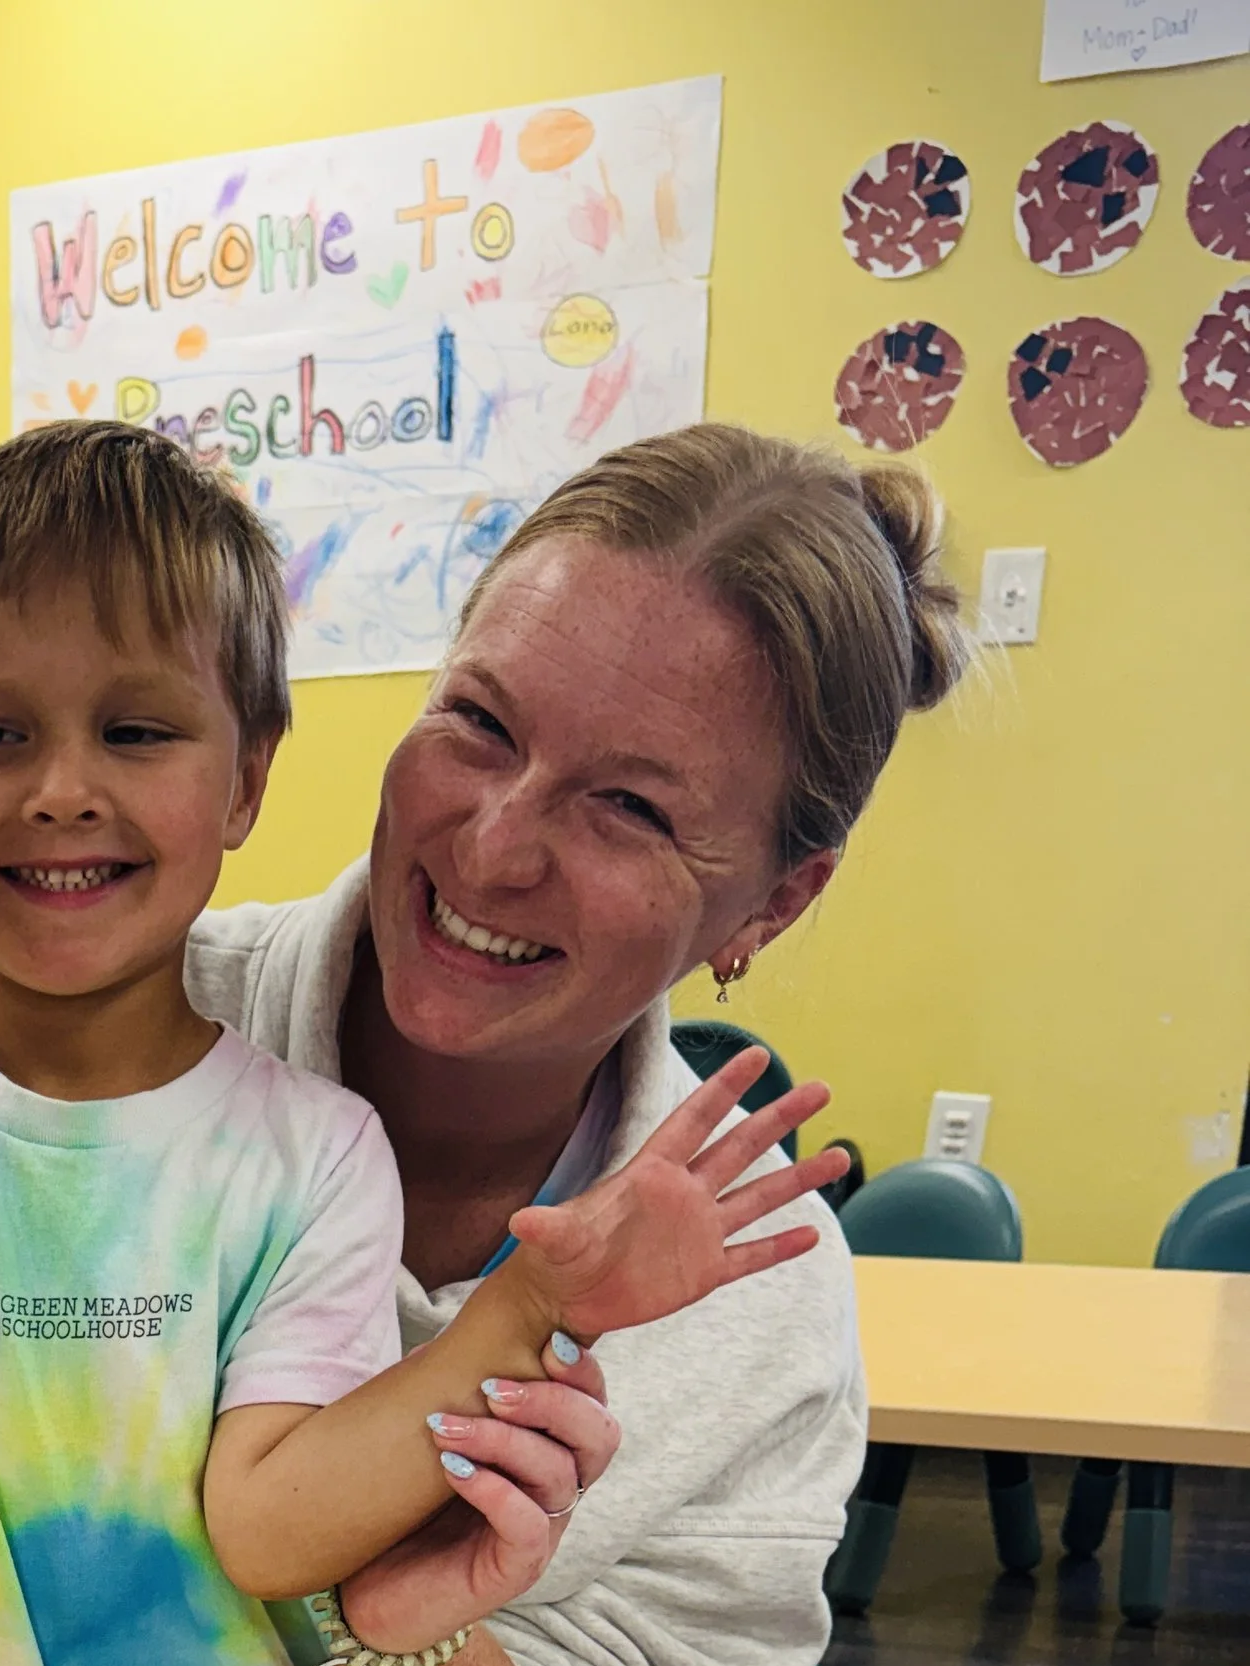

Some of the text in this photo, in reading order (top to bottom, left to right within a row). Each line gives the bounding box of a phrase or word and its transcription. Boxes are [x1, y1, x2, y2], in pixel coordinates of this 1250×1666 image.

[32, 158, 515, 330] Welcome to
[115, 326, 455, 466] Preschool
[0, 1293, 194, 1317] GREEN MEADOWS
[1, 1316, 163, 1340] SCHOOLHOUSE
